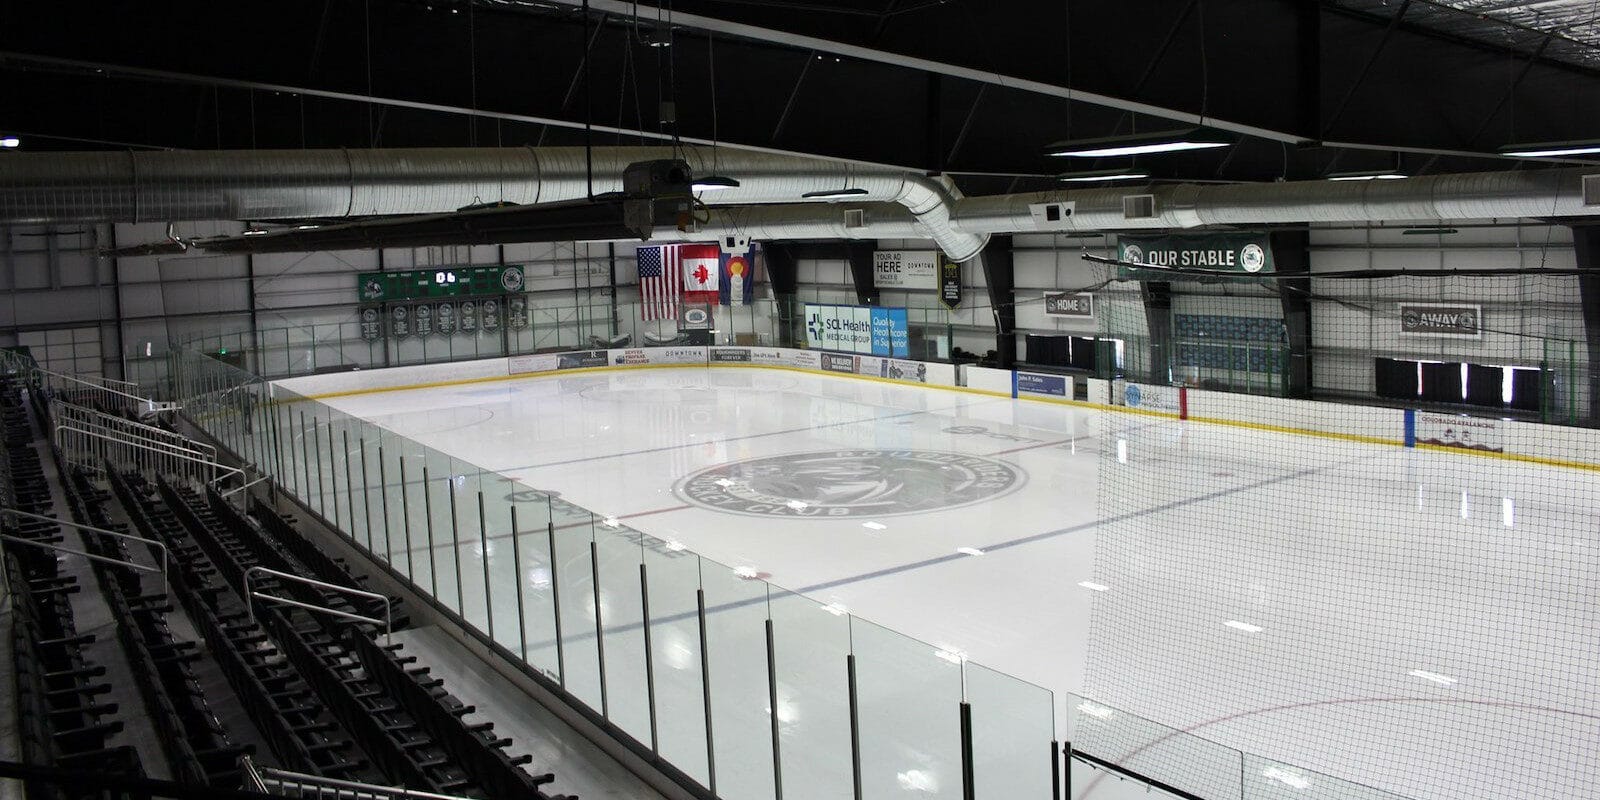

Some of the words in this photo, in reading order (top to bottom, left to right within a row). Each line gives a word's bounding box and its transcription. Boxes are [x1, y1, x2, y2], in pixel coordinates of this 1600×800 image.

[1149, 250, 1177, 266] OUR
[1181, 250, 1235, 266] STABLE
[877, 262, 901, 273] HERE
[1057, 299, 1079, 311] HOME
[826, 318, 842, 330] SCL
[843, 319, 871, 333] Health
[872, 316, 896, 328] Qualty
[1419, 312, 1460, 328] AWAY
[826, 333, 850, 342] MEDICAL
[850, 335, 870, 344] GROUP
[873, 327, 907, 338] Healhcare
[1421, 416, 1456, 426] COLORADO
[745, 503, 850, 517] CLUB
